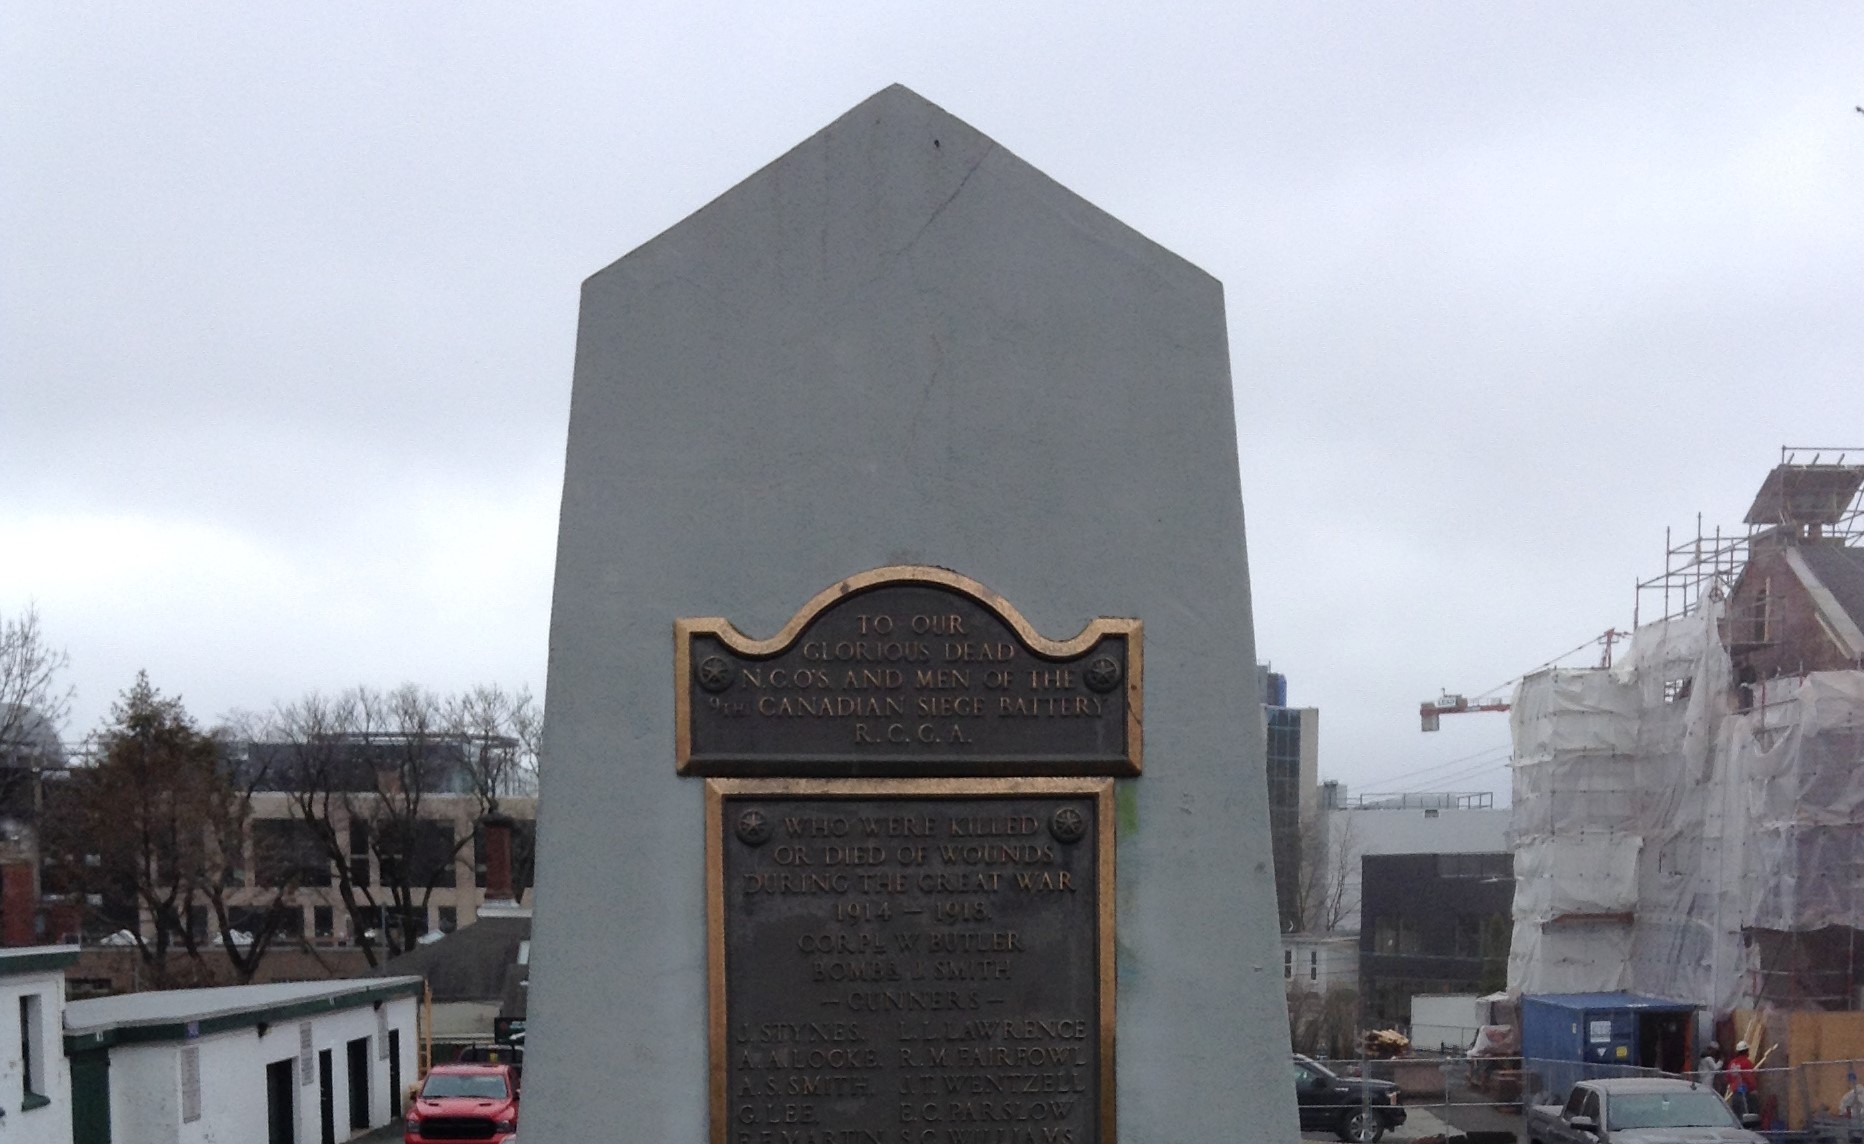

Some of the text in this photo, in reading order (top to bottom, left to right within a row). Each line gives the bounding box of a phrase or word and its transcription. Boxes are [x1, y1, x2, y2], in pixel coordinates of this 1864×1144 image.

[857, 615, 966, 634] TO OUR
[804, 642, 1014, 660] GLORIOUS DEAD
[844, 669, 903, 688] AND
[916, 669, 970, 688] MEN
[983, 670, 1014, 688] OF
[1030, 670, 1075, 688] THE
[758, 697, 904, 716] CANADIAN
[918, 697, 983, 716] SIEGE
[1000, 697, 1107, 716] BATTERY
[784, 817, 1039, 835] WHO WERE KILLED
[774, 845, 1054, 865] OR DIED OF WOUNDS
[744, 871, 1075, 893] DURING THE GREAT WAR
[835, 902, 892, 926] 1914
[930, 932, 1024, 952] BUTLER
[934, 960, 1011, 980] SMITH
[849, 992, 979, 1011] GUNNERS
[945, 1019, 1087, 1040] LAWRENCE
[951, 1100, 1074, 1121] PARSLOW
